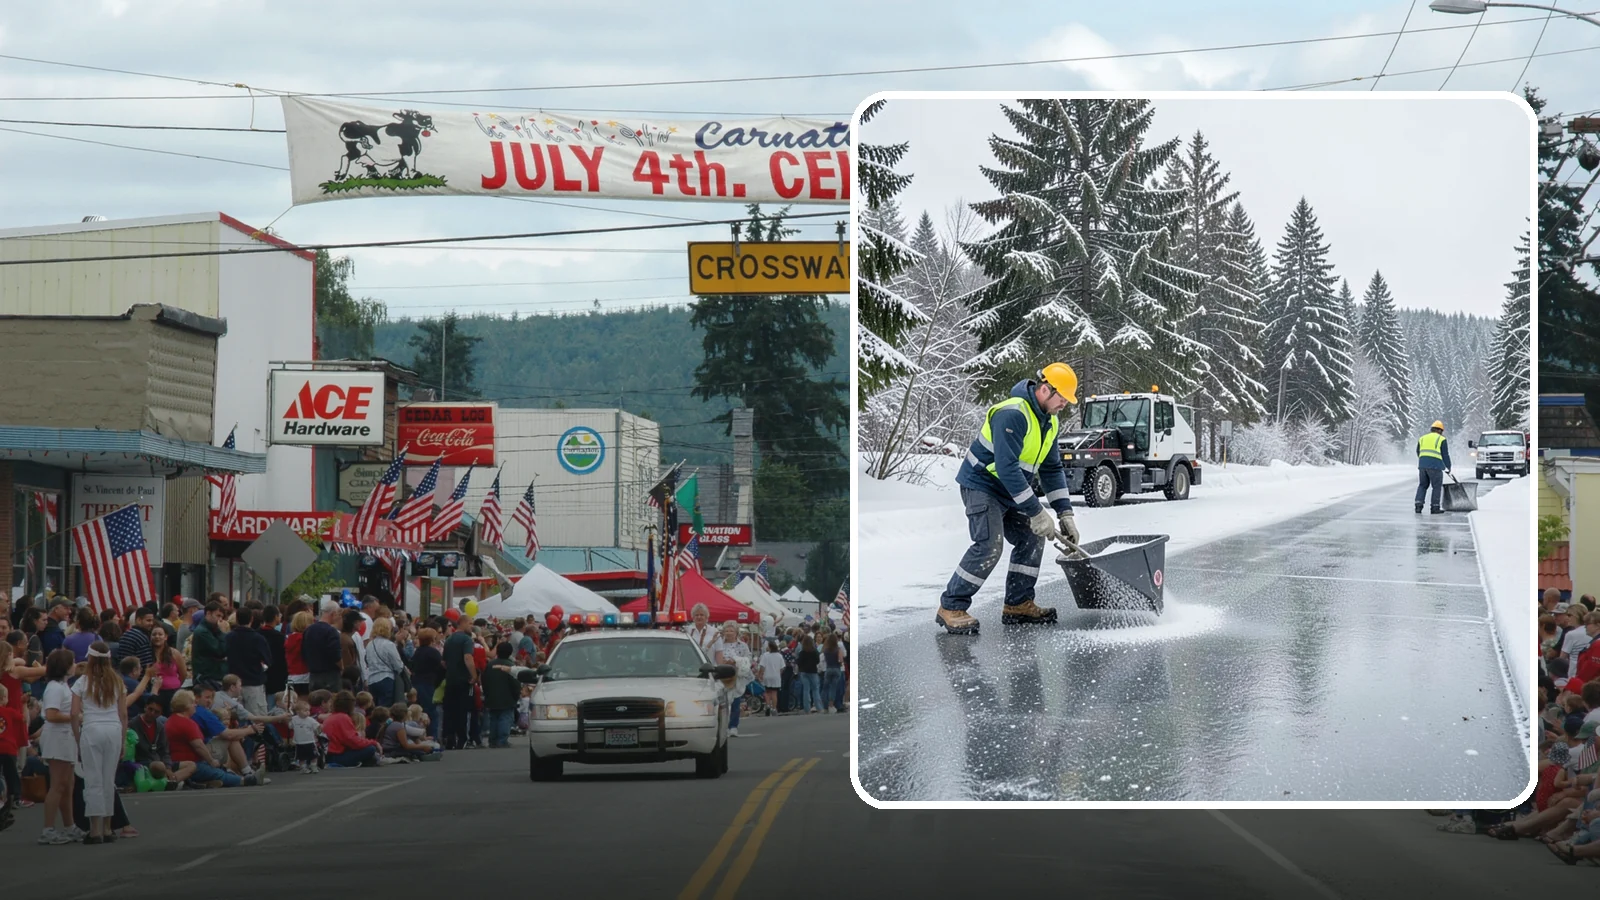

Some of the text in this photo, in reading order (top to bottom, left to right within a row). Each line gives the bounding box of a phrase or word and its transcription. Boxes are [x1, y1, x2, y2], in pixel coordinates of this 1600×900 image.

[695, 121, 850, 150] Carnat
[481, 140, 604, 192] JULY
[632, 150, 746, 198] 4th.
[697, 254, 850, 280] CROSSWA
[282, 380, 374, 420] ACE
[405, 409, 453, 422] CEDAR
[283, 421, 371, 436] Hardware
[416, 428, 477, 447] Coca-Cola
[83, 484, 155, 495] St. Vincent de Paul
[688, 526, 741, 535] CRNATION
[699, 535, 730, 543] GLASS
